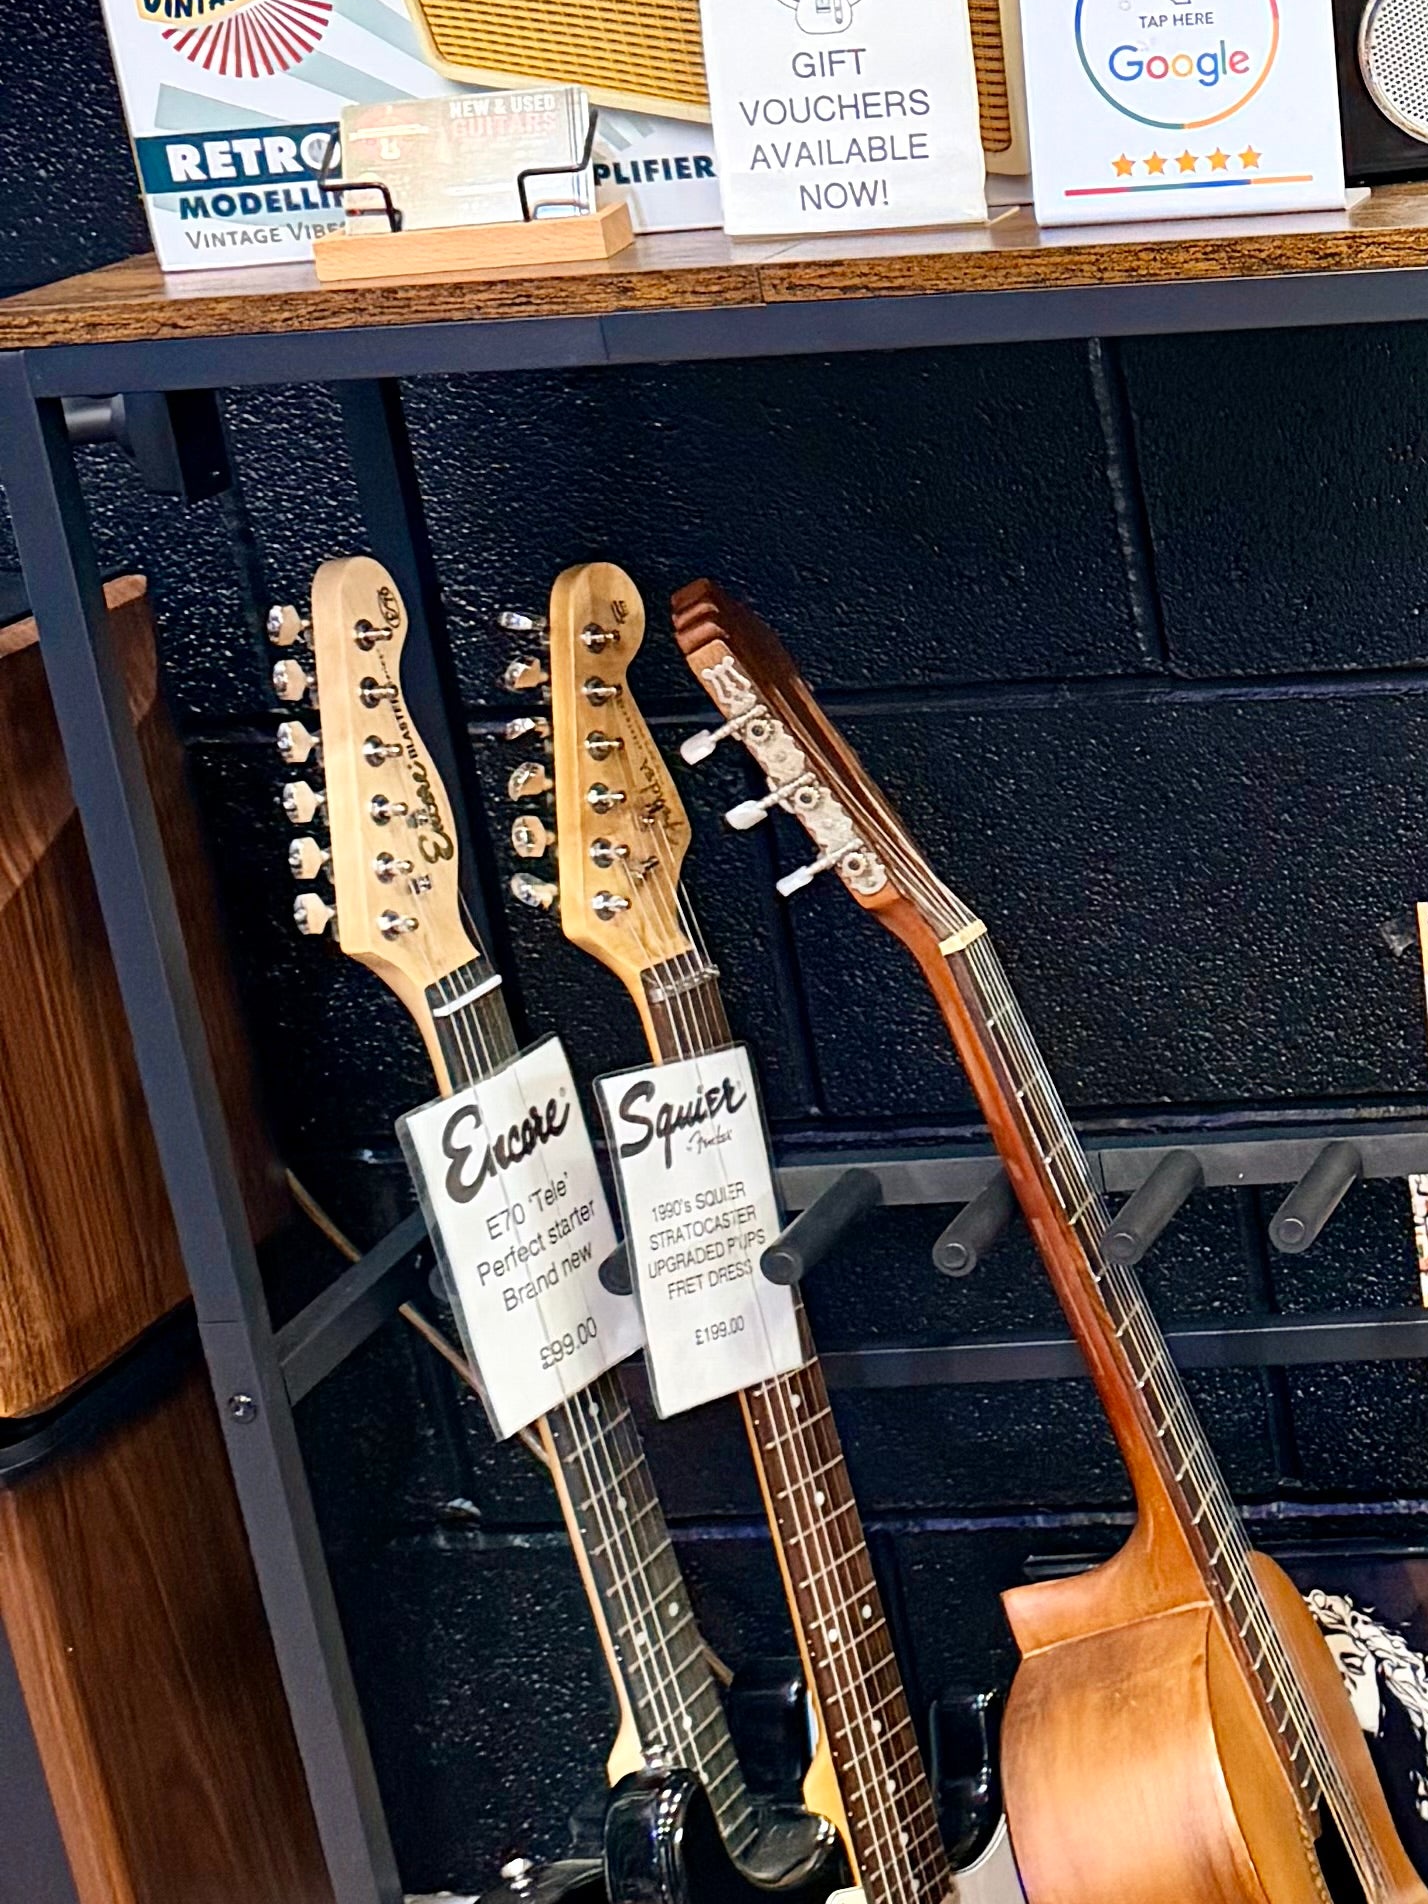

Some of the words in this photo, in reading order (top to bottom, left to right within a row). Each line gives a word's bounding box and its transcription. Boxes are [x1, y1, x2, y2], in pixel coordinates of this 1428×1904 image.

[1138, 12, 1169, 28] TAP
[1172, 10, 1214, 27] HERE
[790, 48, 866, 82] GIFT
[1108, 42, 1250, 88] Google
[448, 98, 490, 120] NEW
[494, 97, 509, 116] &
[510, 93, 556, 114] USED
[738, 87, 932, 125] VOUCHERS
[166, 132, 342, 183] RETRO
[748, 132, 930, 171] AVAILABLE
[179, 187, 343, 221] MODELLI
[594, 153, 715, 188] PLIFIER
[798, 178, 891, 212] NOW!
[185, 226, 283, 250] VINTAGE
[619, 1076, 748, 1170] Squier
[441, 1096, 571, 1204] Encore
[695, 1181, 746, 1211] SQUIER
[476, 1235, 547, 1287] Perfect
[547, 1199, 597, 1246] starter
[485, 1203, 527, 1242] E70
[649, 1204, 758, 1252] STRATOCASTER
[502, 1270, 560, 1313] Brand
[561, 1244, 593, 1278] new
[647, 1240, 726, 1281] UPGRADED
[667, 1273, 706, 1301] FRET
[708, 1258, 753, 1289] DRESS
[540, 1316, 598, 1371] £99.00
[694, 1315, 745, 1347] £199.00
